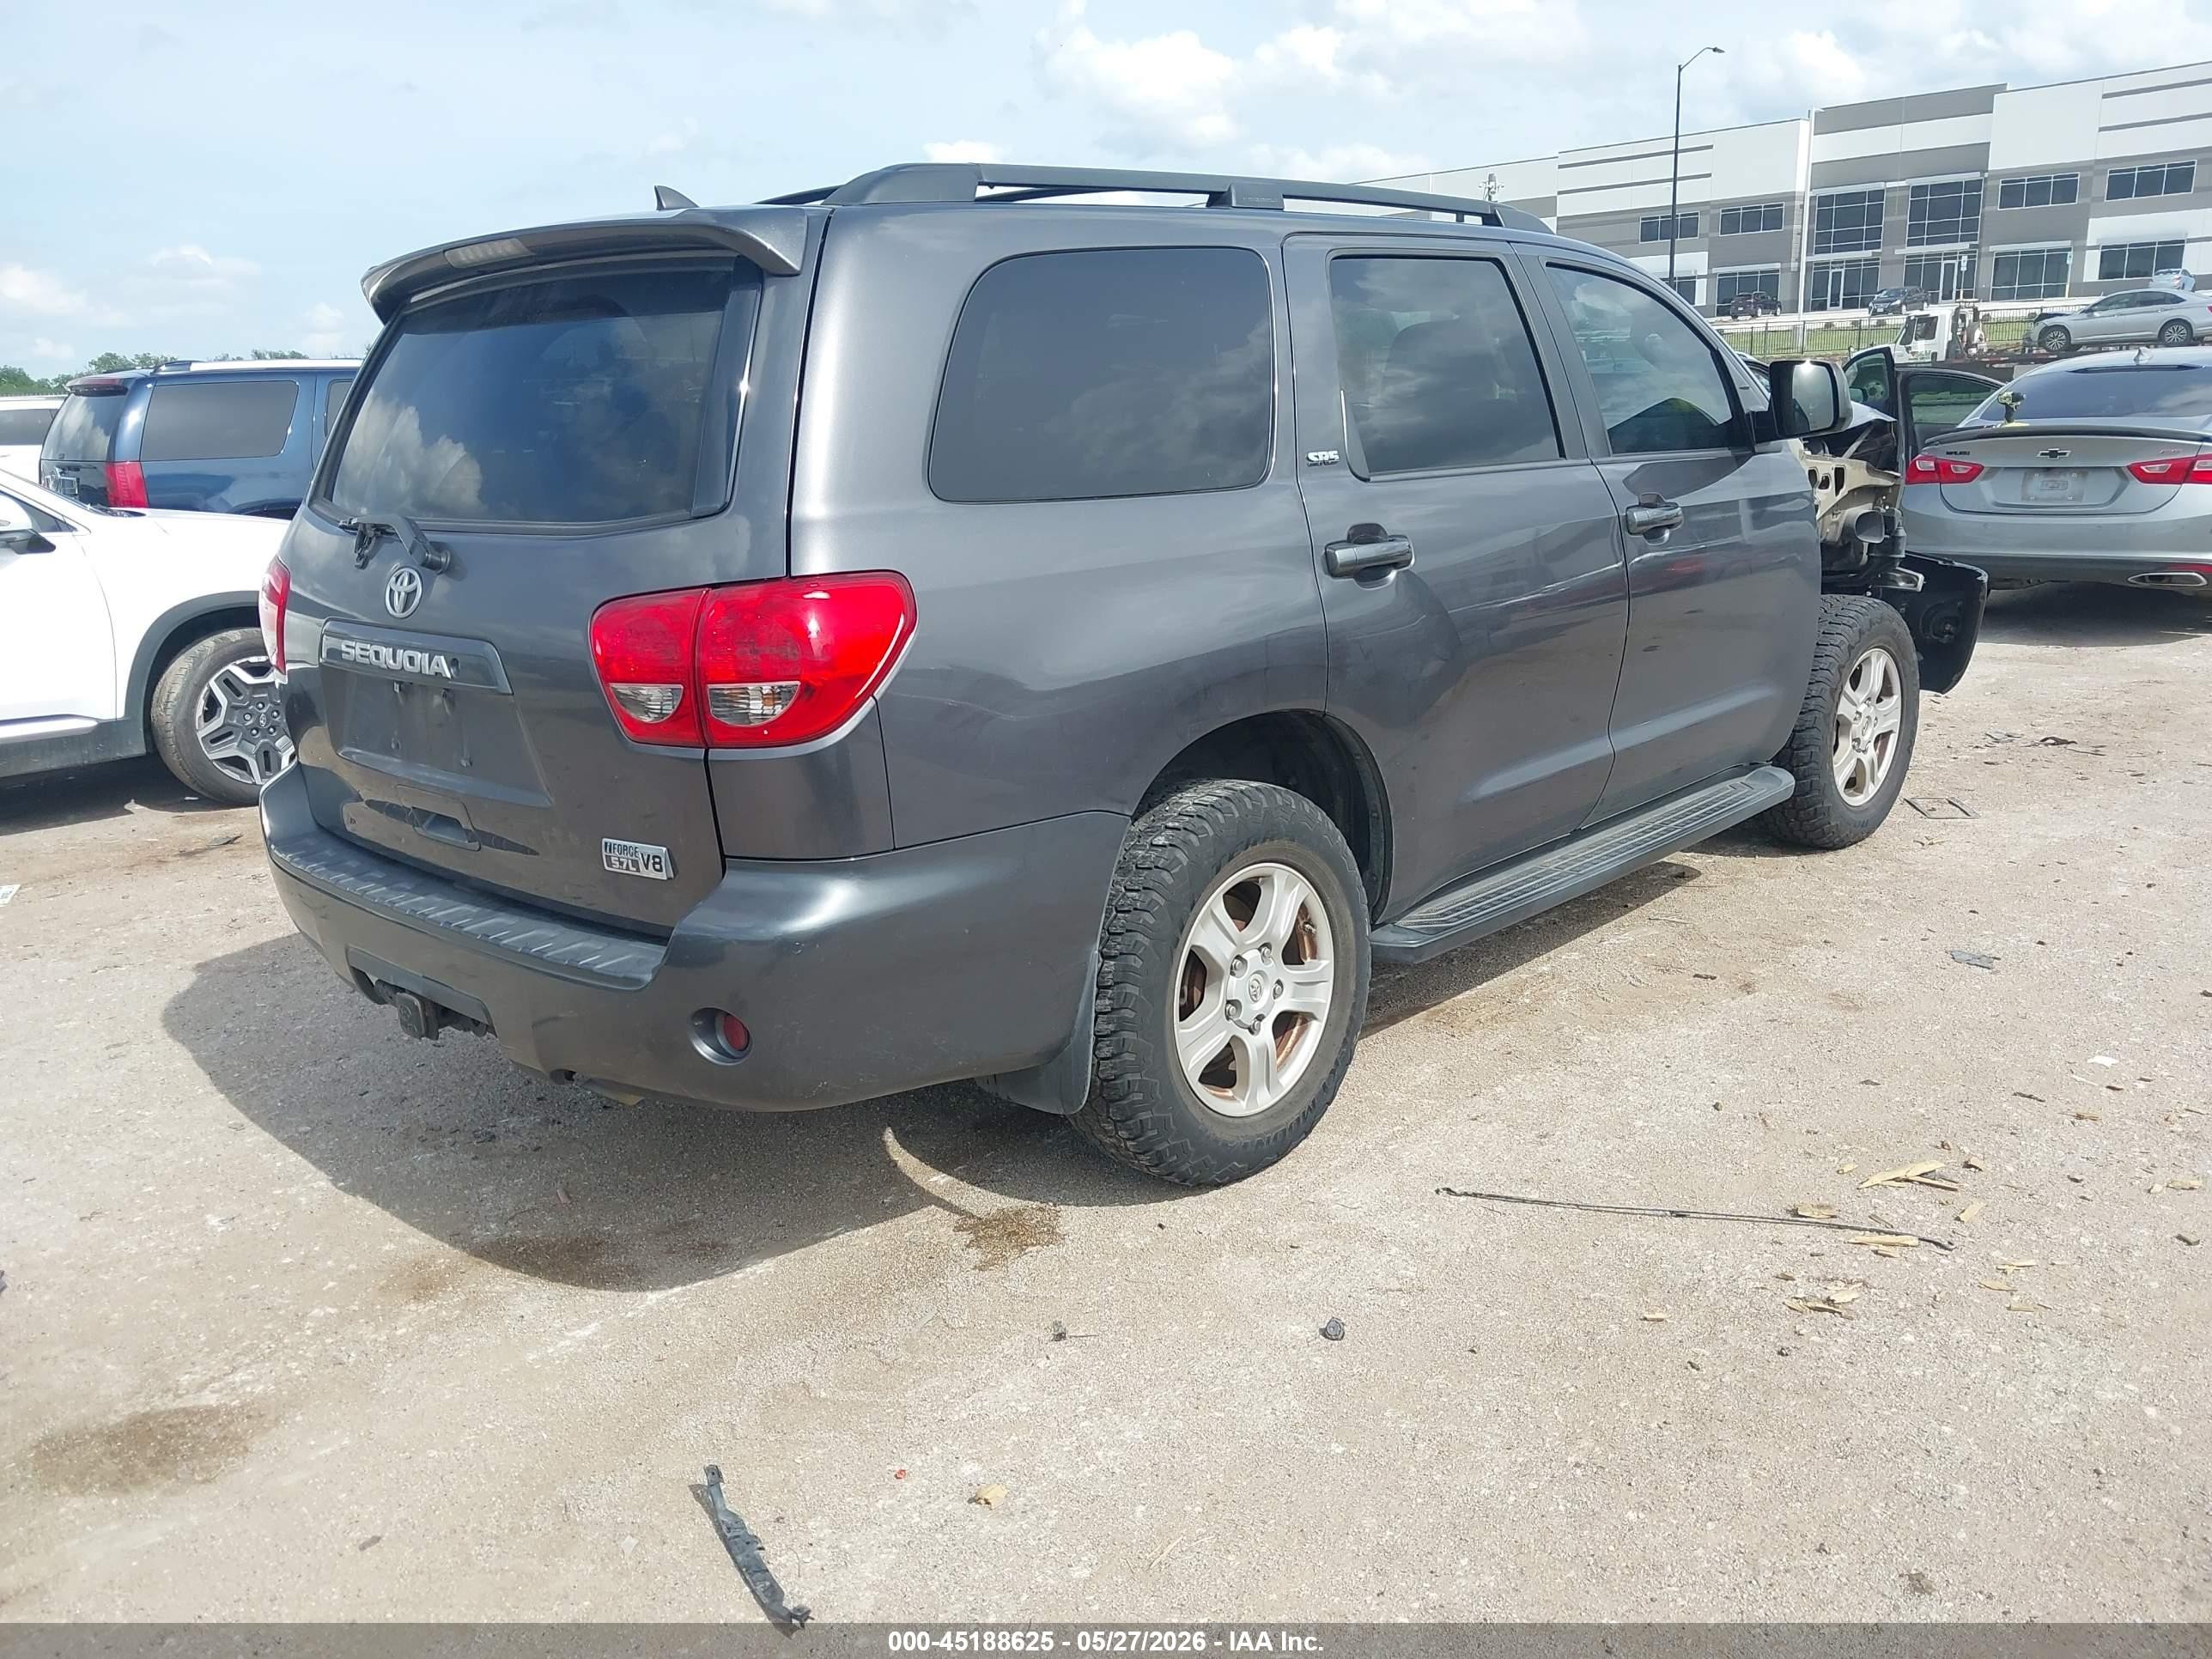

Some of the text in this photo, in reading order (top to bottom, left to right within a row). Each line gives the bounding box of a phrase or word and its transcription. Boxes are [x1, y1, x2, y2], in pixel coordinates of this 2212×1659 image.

[341, 639, 452, 679] SEQUOIA
[611, 857, 637, 871] 5.7L
[641, 853, 665, 873] V8
